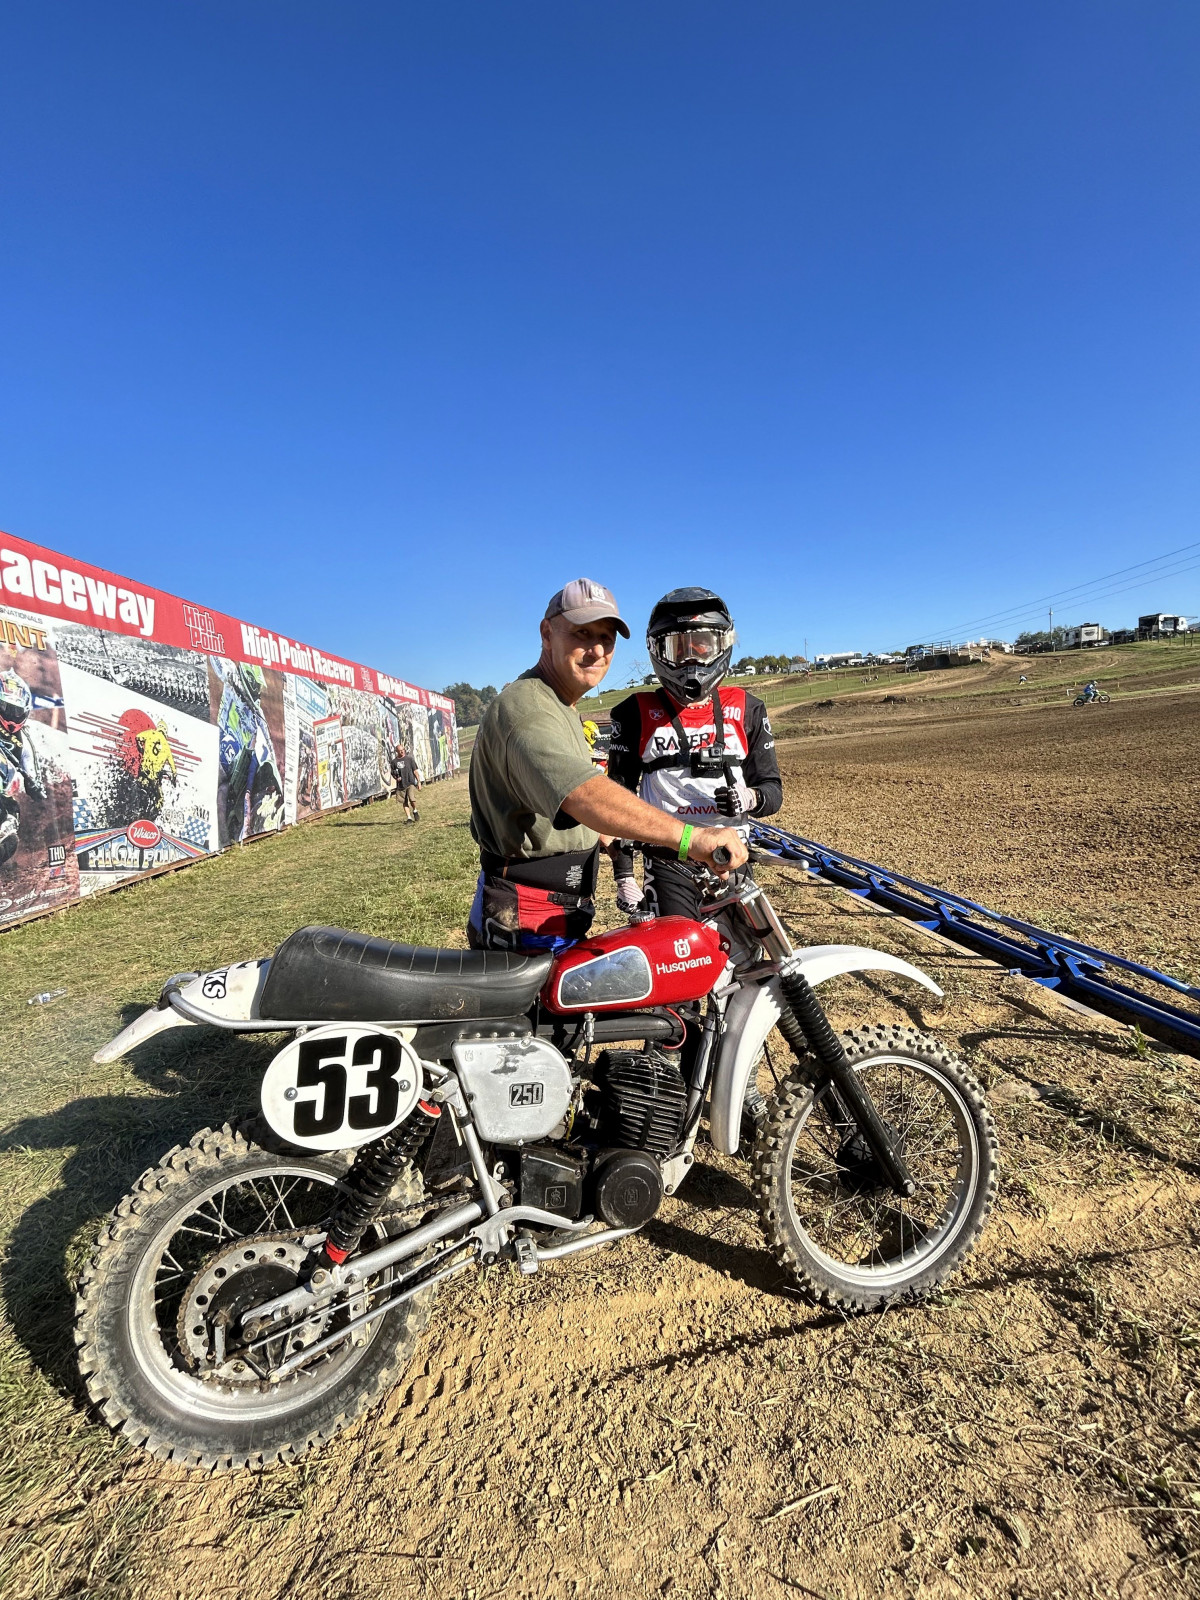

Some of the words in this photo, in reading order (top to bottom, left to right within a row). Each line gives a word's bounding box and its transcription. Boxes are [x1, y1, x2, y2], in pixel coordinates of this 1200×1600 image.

[0, 548, 155, 637] aceway
[182, 603, 216, 634] High
[189, 625, 226, 654] Point
[240, 623, 280, 666] High
[278, 636, 313, 673] Point
[311, 648, 355, 688] Raceway
[723, 705, 742, 721] 310
[653, 732, 711, 751] RAER
[655, 955, 713, 975] Husqvarna
[293, 1033, 403, 1138] 53
[511, 1083, 543, 1107] 250
